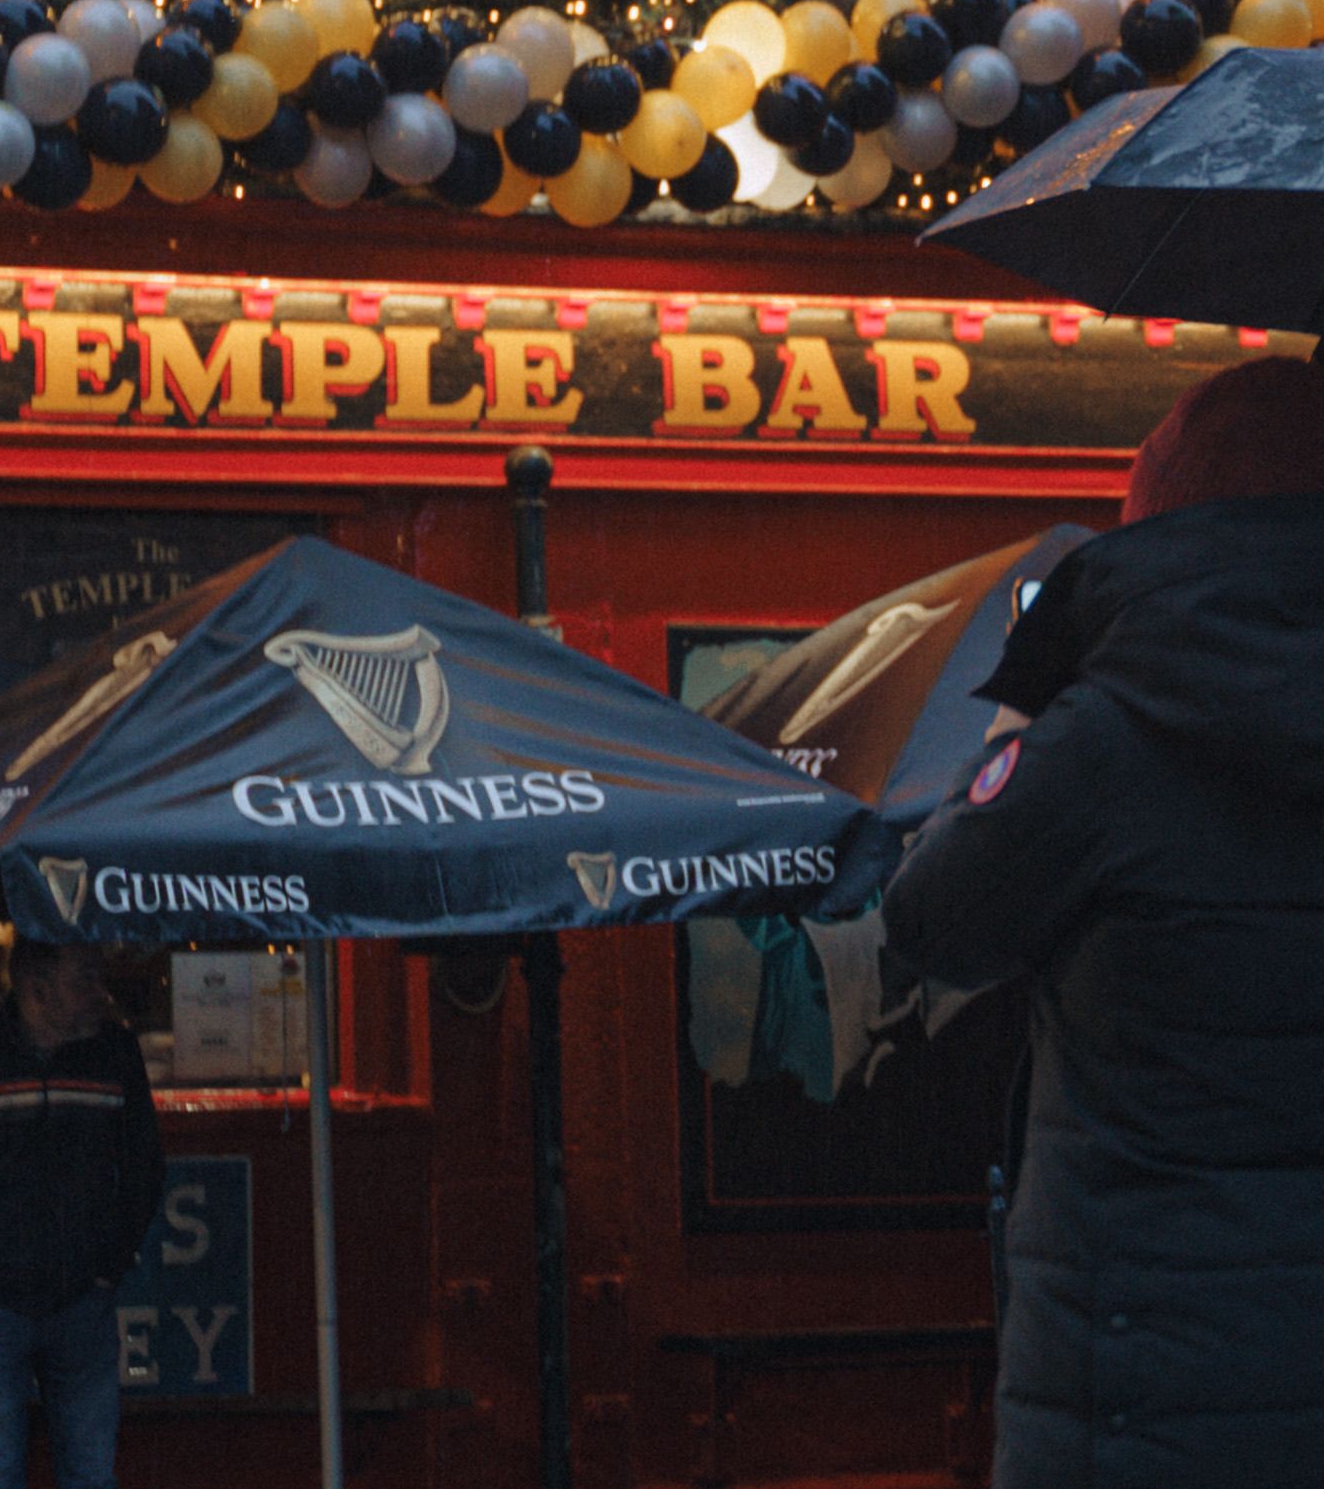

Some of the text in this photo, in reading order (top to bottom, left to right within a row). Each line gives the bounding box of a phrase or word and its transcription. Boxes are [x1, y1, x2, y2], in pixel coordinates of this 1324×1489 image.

[651, 333, 975, 440] BAR
[134, 537, 179, 564] The
[20, 571, 193, 621] TEMPLE
[231, 770, 605, 828] GUINNESS
[94, 866, 310, 914] GUINNESS
[622, 846, 836, 897] GUINNESS
